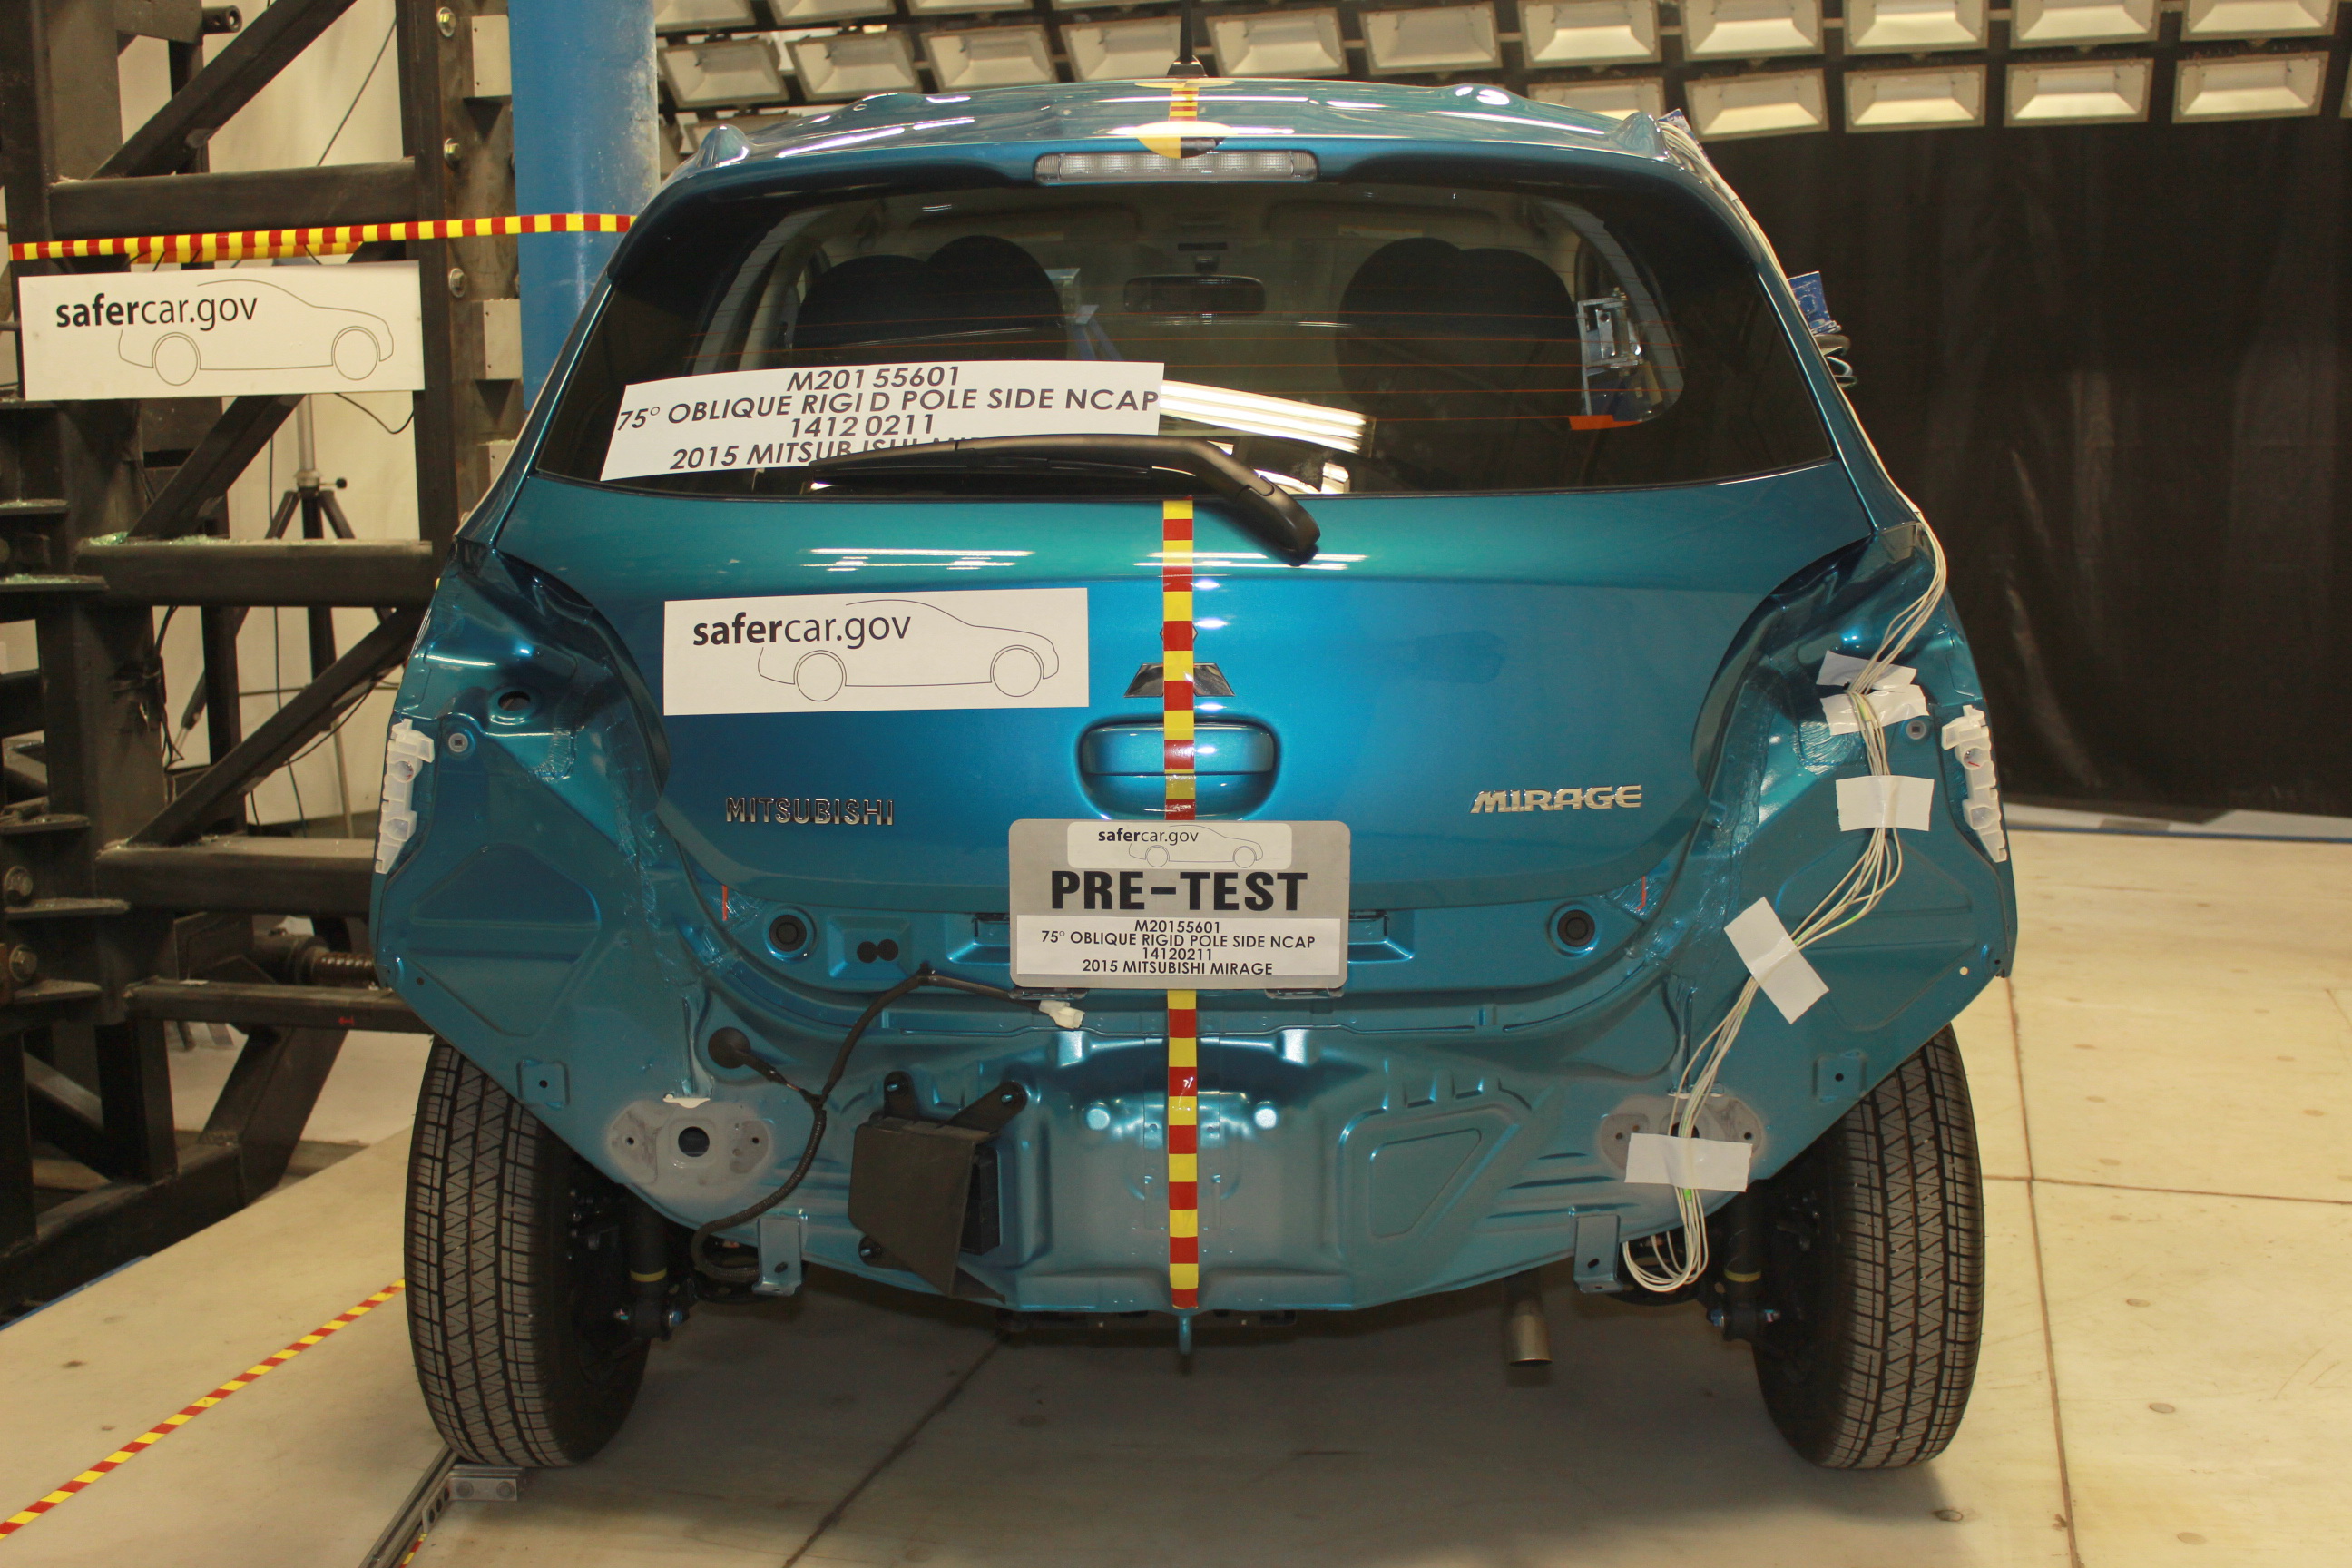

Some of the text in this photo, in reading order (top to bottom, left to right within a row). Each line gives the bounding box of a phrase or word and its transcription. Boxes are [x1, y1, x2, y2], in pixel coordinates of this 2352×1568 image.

[56, 293, 258, 331] safercar.gov
[617, 406, 661, 431] 75°
[668, 395, 792, 424] OBLIQUE
[901, 388, 978, 411] POLE
[987, 388, 1054, 409] SIDE
[1065, 388, 1159, 412] NCAP
[669, 446, 740, 470] 2015
[693, 612, 911, 649] safercar.gov
[725, 796, 895, 826] MITSUBISHI
[1470, 784, 1642, 814] MIRAGE
[1098, 827, 1199, 846] safercar.gov
[1051, 870, 1308, 912] PRE-TEST
[1041, 930, 1316, 949] 75° OBLIQUE RIGID POLE SIDE NCAP
[1134, 919, 1220, 934] M20155601
[1082, 958, 1273, 975] 2015 MITSUBISHI MIRAGE
[1142, 946, 1211, 961] 14120211
